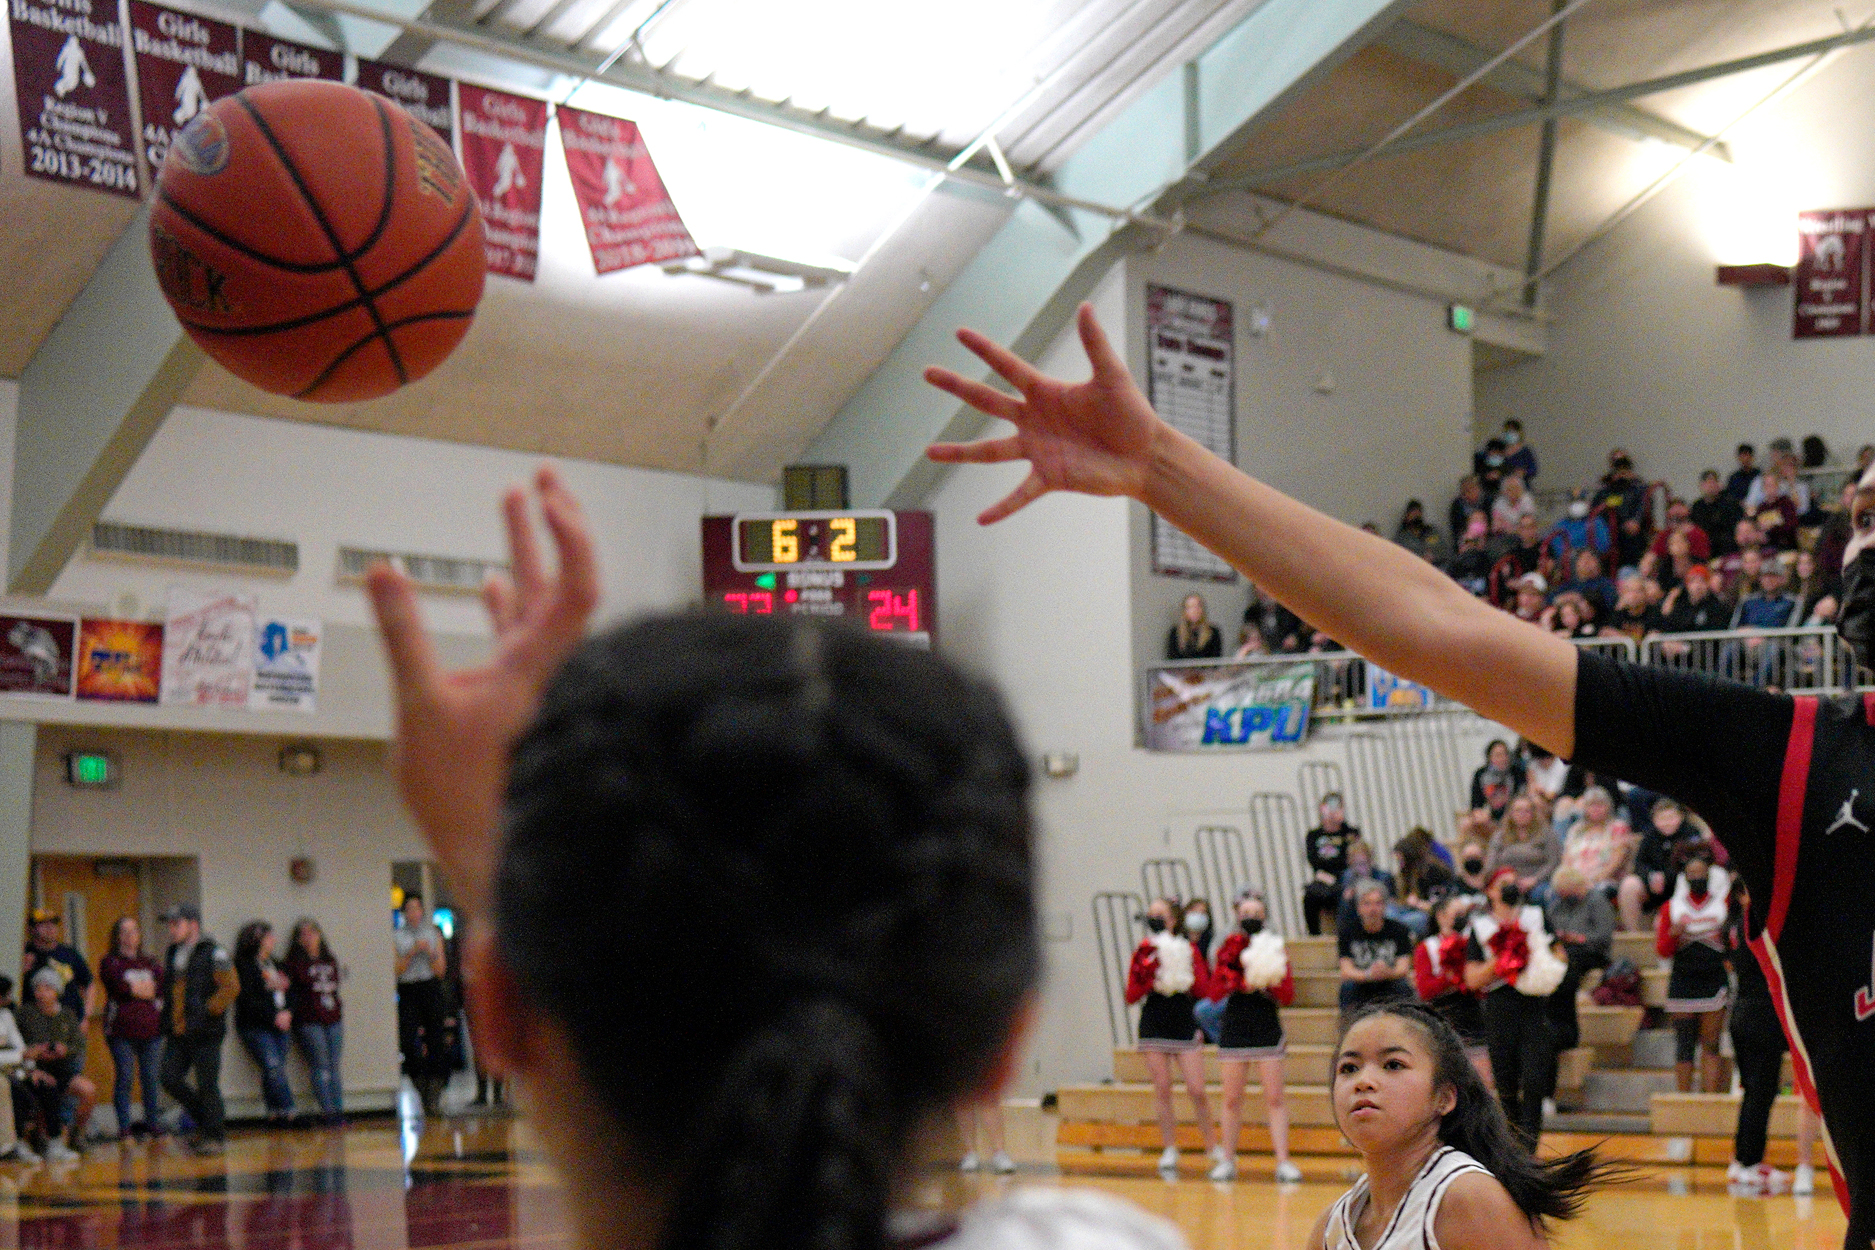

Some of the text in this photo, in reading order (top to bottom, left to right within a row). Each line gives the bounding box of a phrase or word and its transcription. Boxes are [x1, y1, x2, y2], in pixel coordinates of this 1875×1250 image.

[157, 11, 211, 45] Girls
[867, 588, 919, 631] 24
[1201, 705, 1309, 745] KPU
